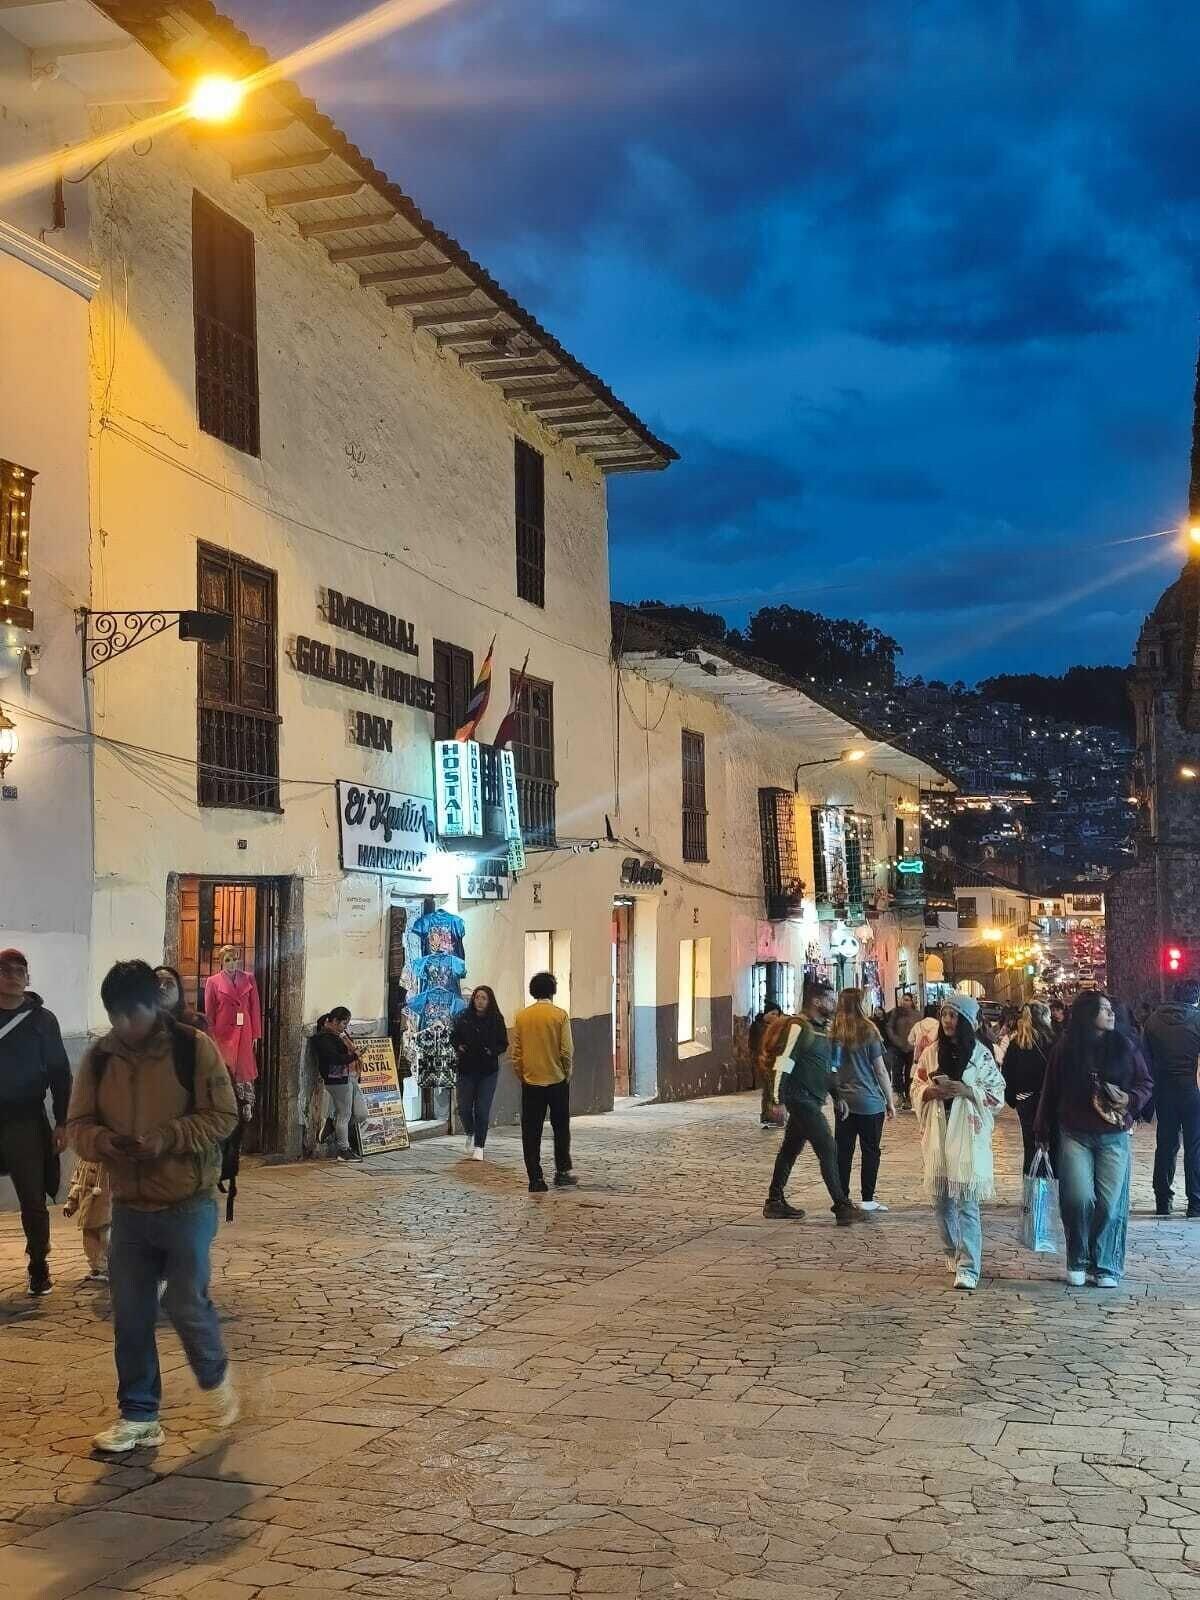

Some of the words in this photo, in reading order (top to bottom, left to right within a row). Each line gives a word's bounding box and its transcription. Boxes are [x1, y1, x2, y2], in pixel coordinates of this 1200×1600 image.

[327, 588, 419, 657] IMPERIAL
[296, 635, 376, 694] GOLDEN
[381, 664, 436, 713] HOUSE
[356, 711, 393, 752] INN
[441, 743, 462, 825] HOSTAL
[470, 743, 479, 825] HOSTAL
[503, 753, 516, 830] HOSTAL
[362, 1060, 392, 1073] OSTAL
